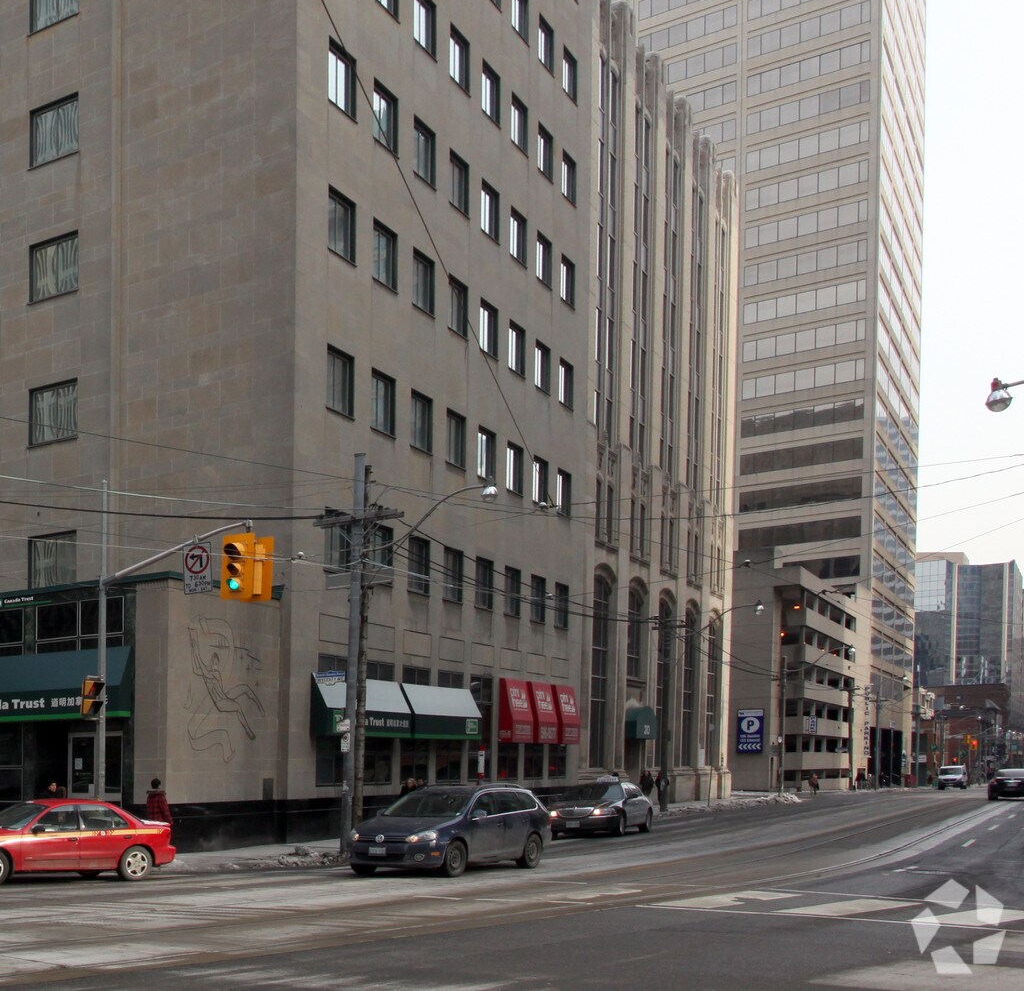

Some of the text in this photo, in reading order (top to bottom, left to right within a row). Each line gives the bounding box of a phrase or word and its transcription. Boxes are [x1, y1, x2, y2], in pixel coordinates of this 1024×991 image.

[12, 698, 46, 710] Trust
[369, 717, 385, 727] Trust
[747, 720, 755, 731] P
